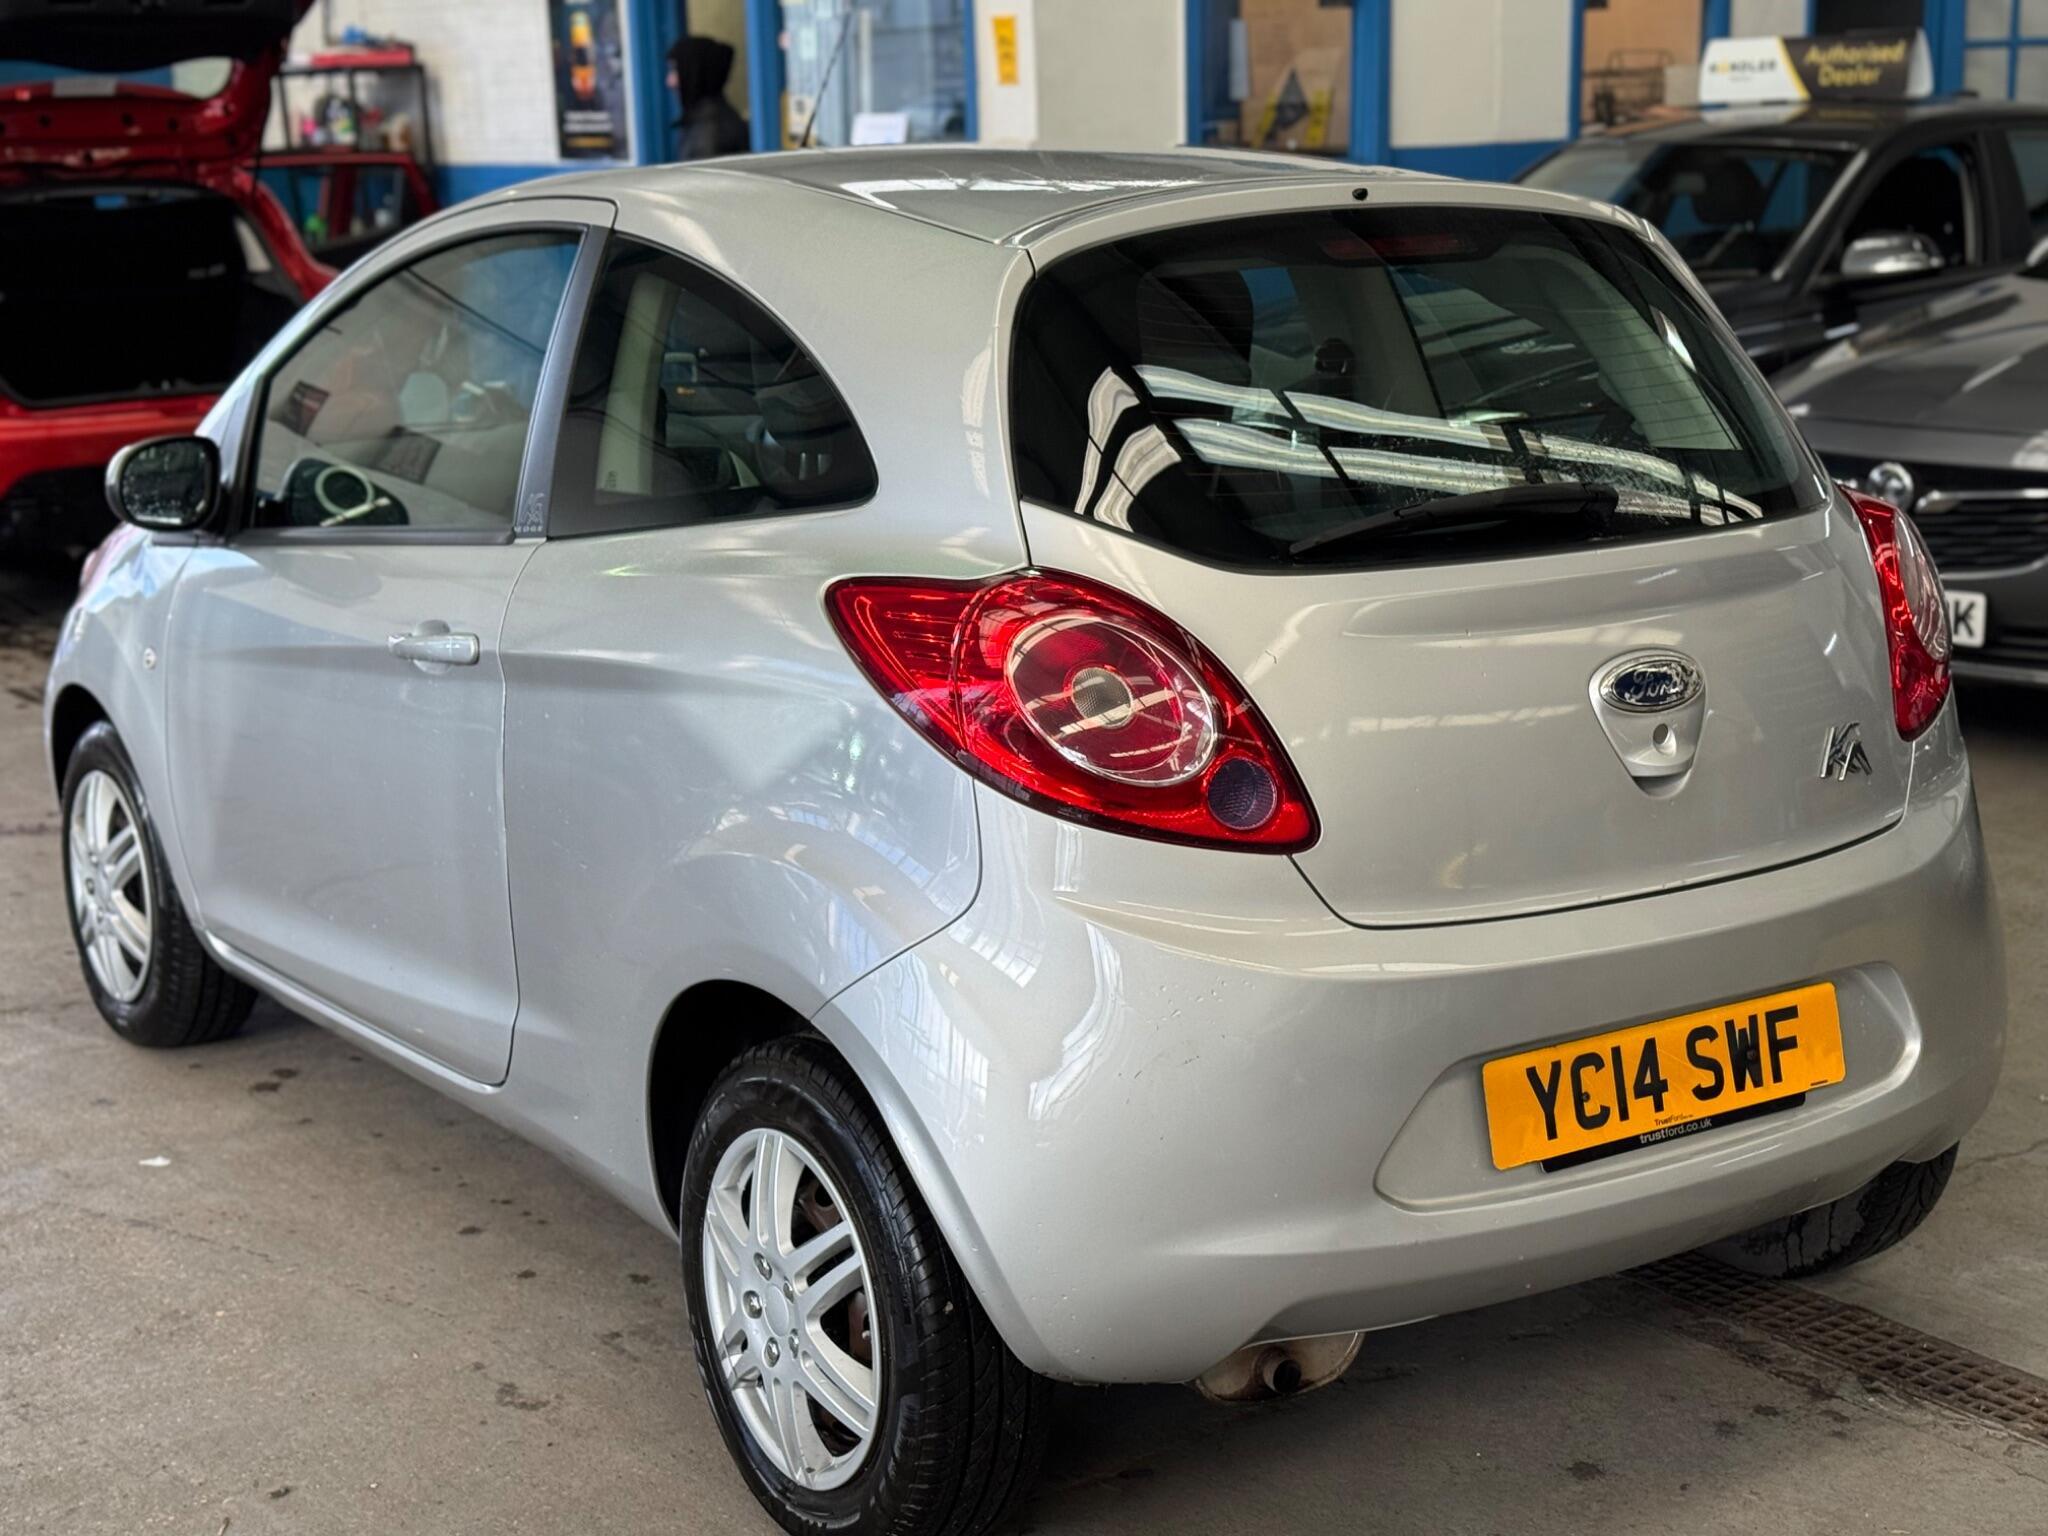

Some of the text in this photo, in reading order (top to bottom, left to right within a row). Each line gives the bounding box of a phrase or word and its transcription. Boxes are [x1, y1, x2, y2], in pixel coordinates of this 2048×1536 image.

[1818, 65, 1881, 87] Dealer
[1625, 666, 1682, 700] Ford
[1526, 1005, 1799, 1141] YC14 SWF
[1640, 1118, 1712, 1144] trustford.co.uk
